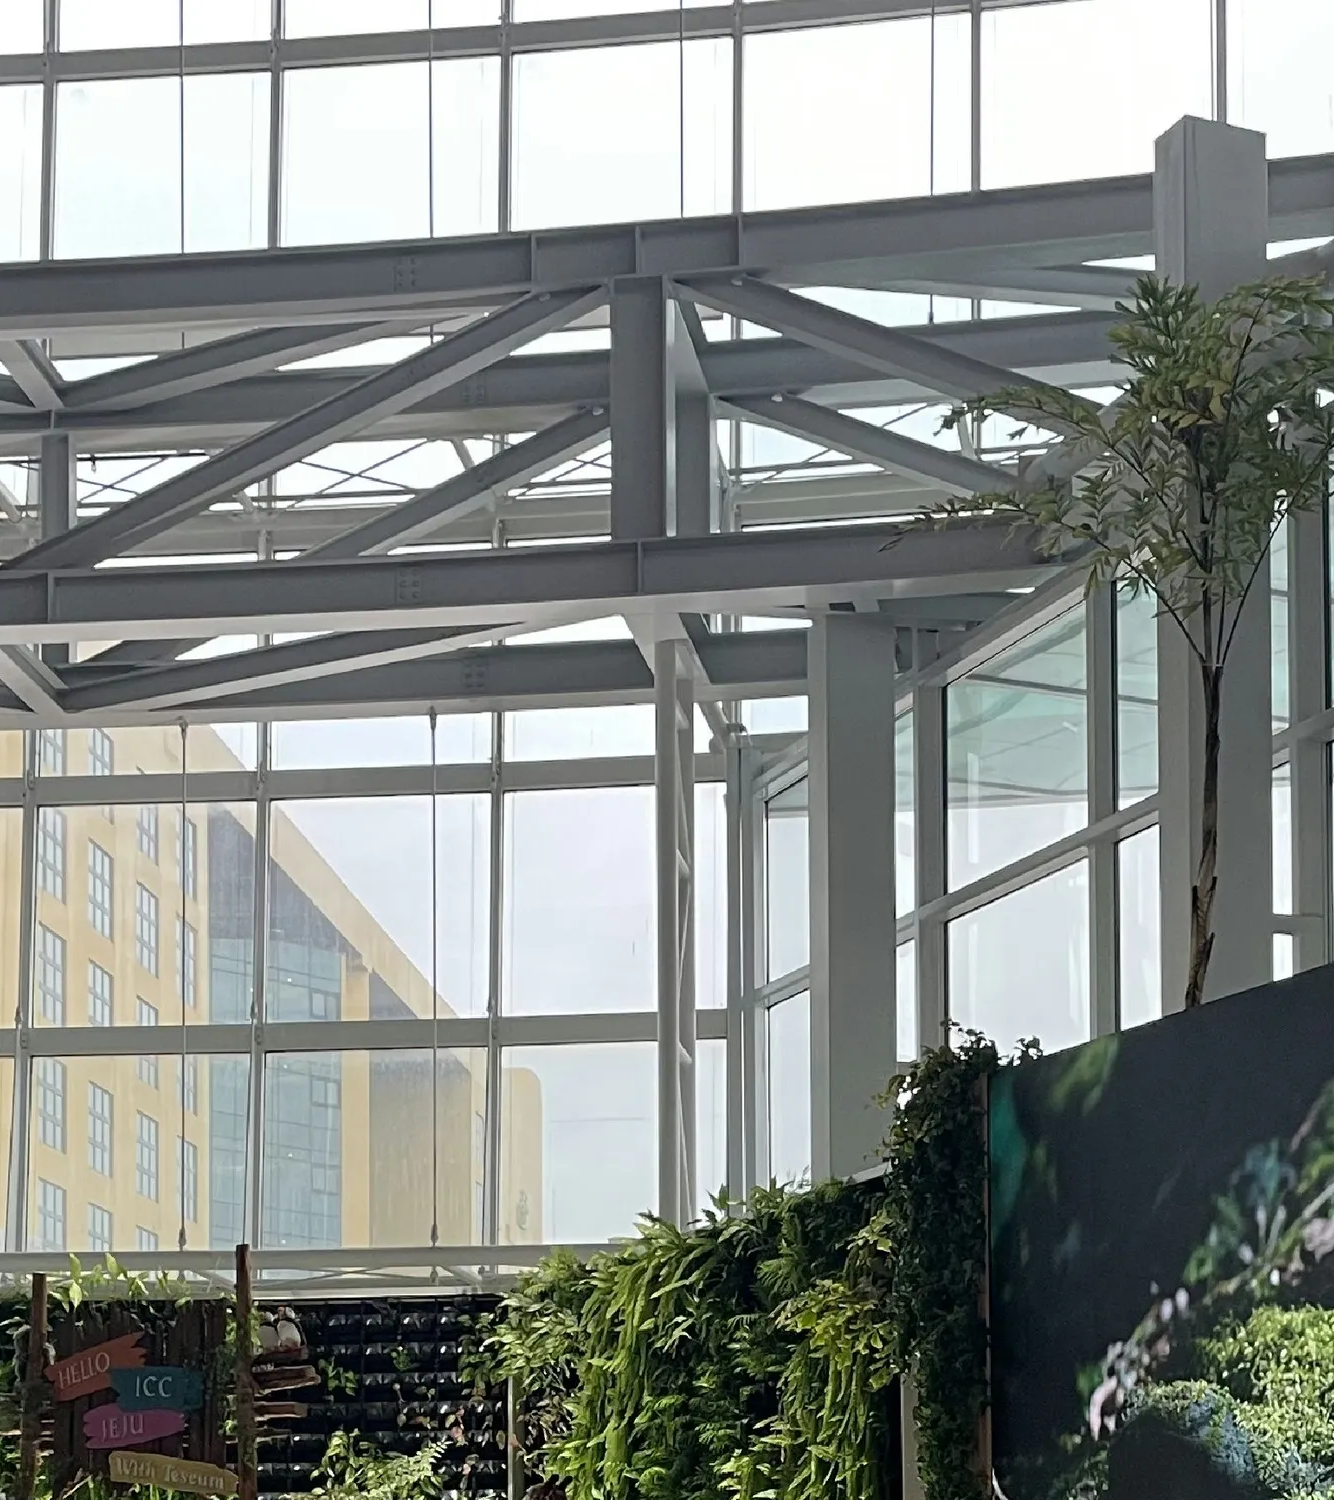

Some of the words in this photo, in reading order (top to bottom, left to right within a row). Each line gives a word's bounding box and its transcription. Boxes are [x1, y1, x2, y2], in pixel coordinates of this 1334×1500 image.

[58, 1352, 111, 1389] HELLO
[135, 1375, 172, 1397] ICC
[101, 1413, 144, 1442] JEJU
[115, 1456, 156, 1480] With
